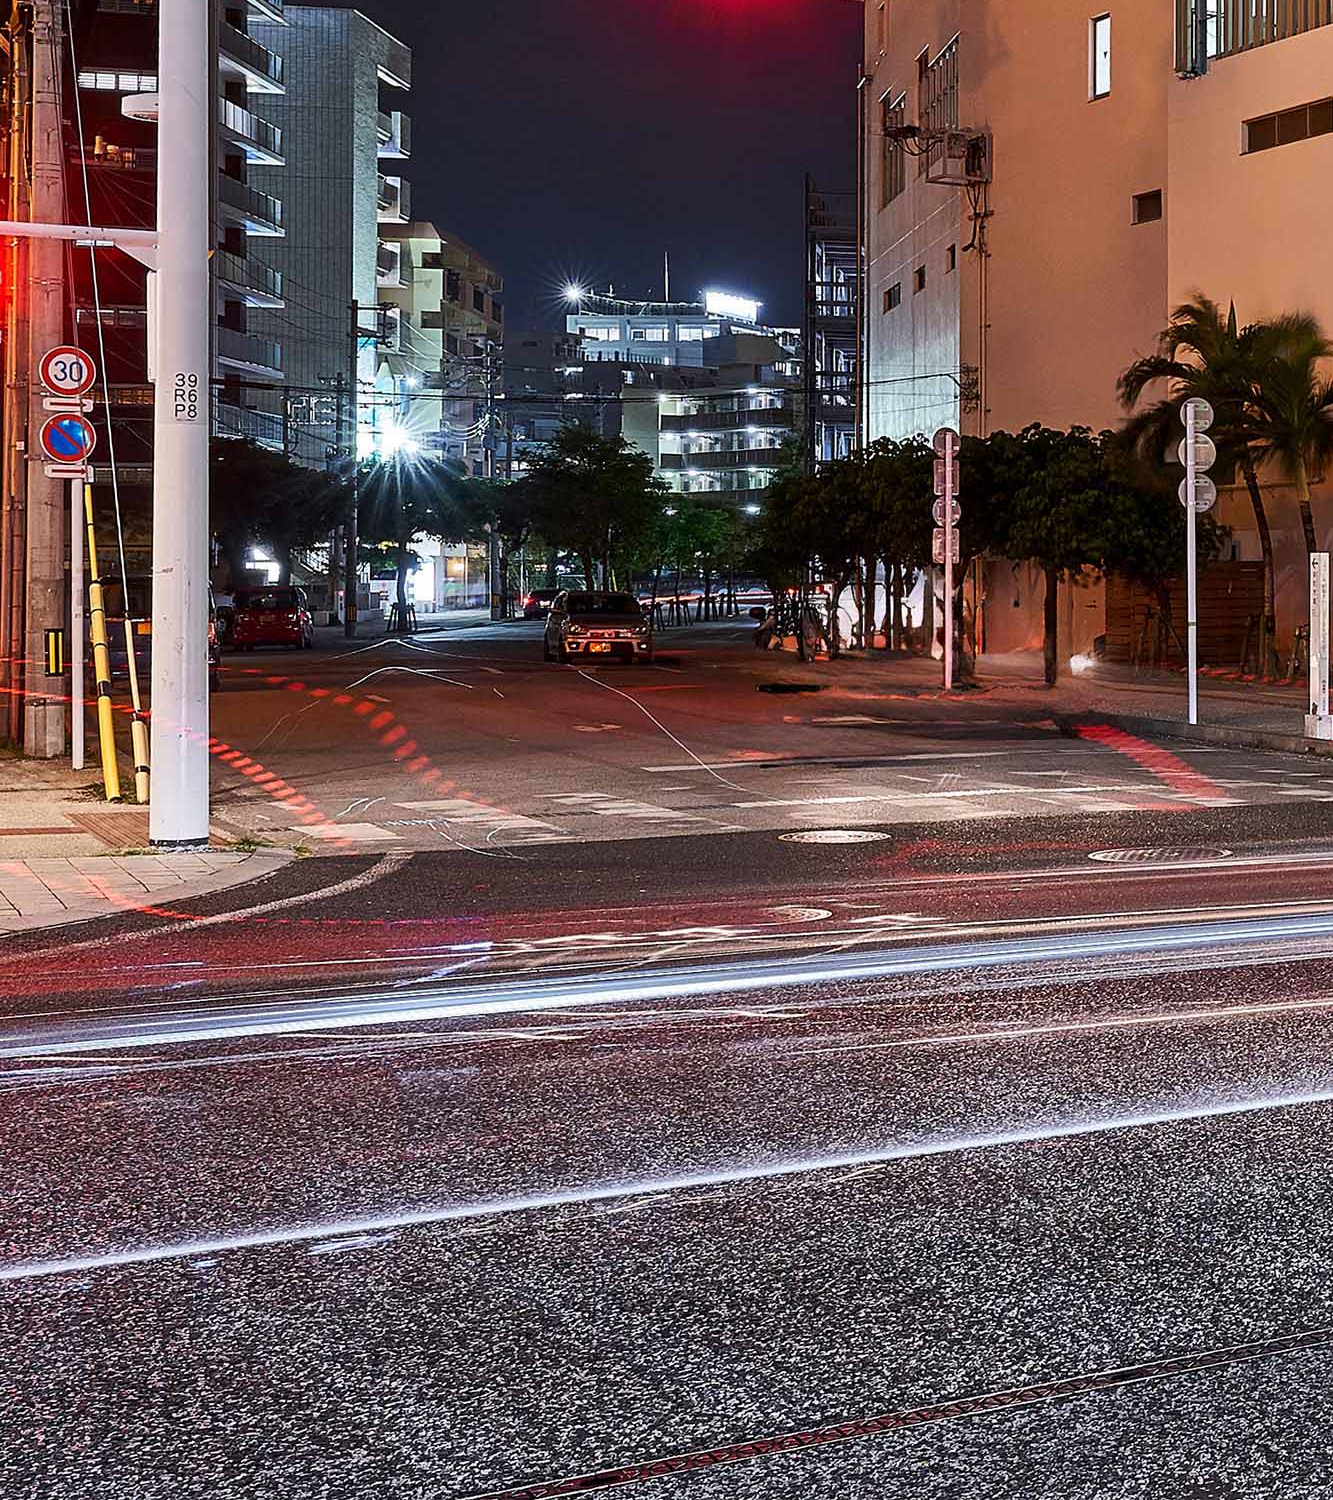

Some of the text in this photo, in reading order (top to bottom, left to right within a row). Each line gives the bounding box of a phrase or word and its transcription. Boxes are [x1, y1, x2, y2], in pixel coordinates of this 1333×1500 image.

[53, 360, 84, 383] 30
[174, 373, 199, 389] 39
[174, 389, 199, 404] R6
[174, 404, 199, 419] P8
